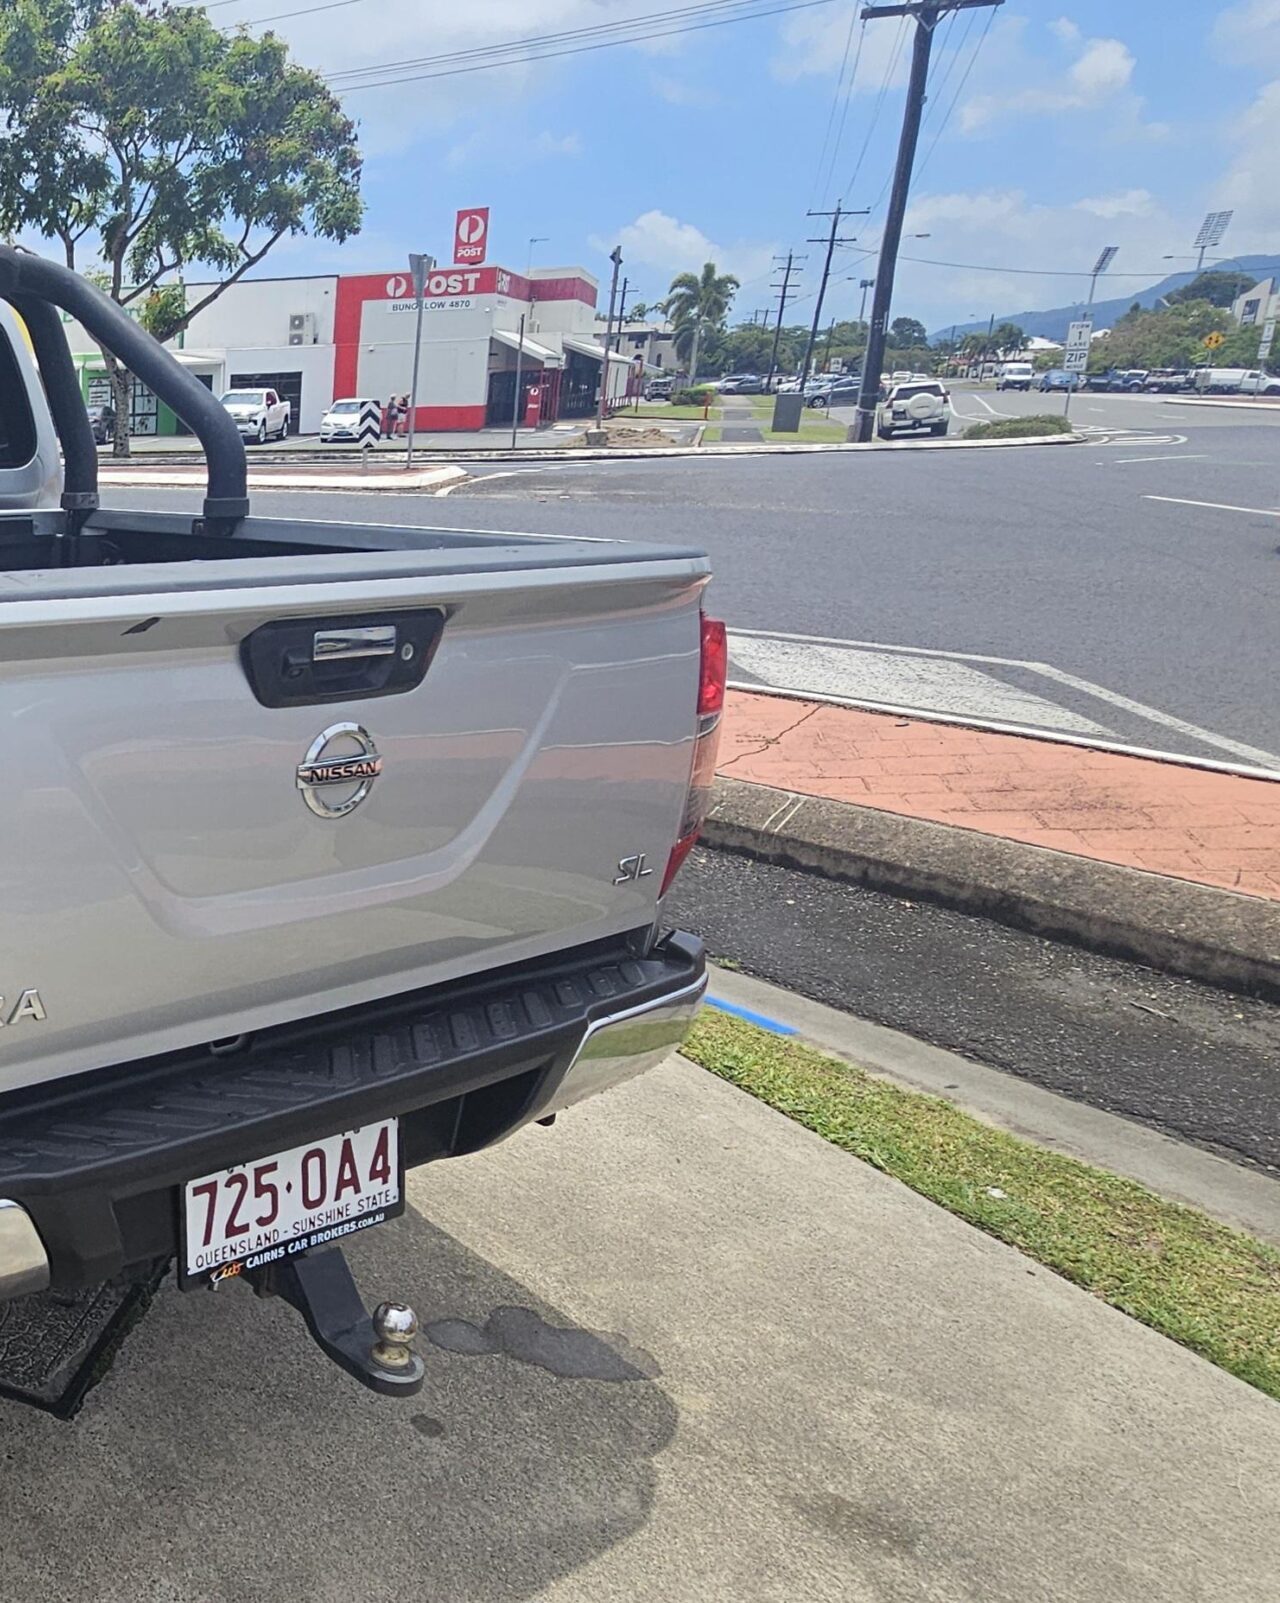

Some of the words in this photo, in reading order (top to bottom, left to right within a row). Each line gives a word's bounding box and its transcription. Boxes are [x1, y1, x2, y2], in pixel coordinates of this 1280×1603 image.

[457, 247, 483, 257] POST
[413, 272, 481, 295] OST
[392, 302, 446, 311] BUNGLOW
[448, 300, 471, 308] 4870
[1066, 352, 1087, 362] ZIP
[310, 761, 377, 782] NISSAN
[613, 853, 653, 885] SL
[196, 1229, 280, 1269] QUEENSLAND
[292, 1203, 351, 1235] SUNSHINE
[357, 1189, 391, 1212] STATE
[246, 1246, 285, 1269] CAIRNS
[287, 1238, 308, 1254] CAR
